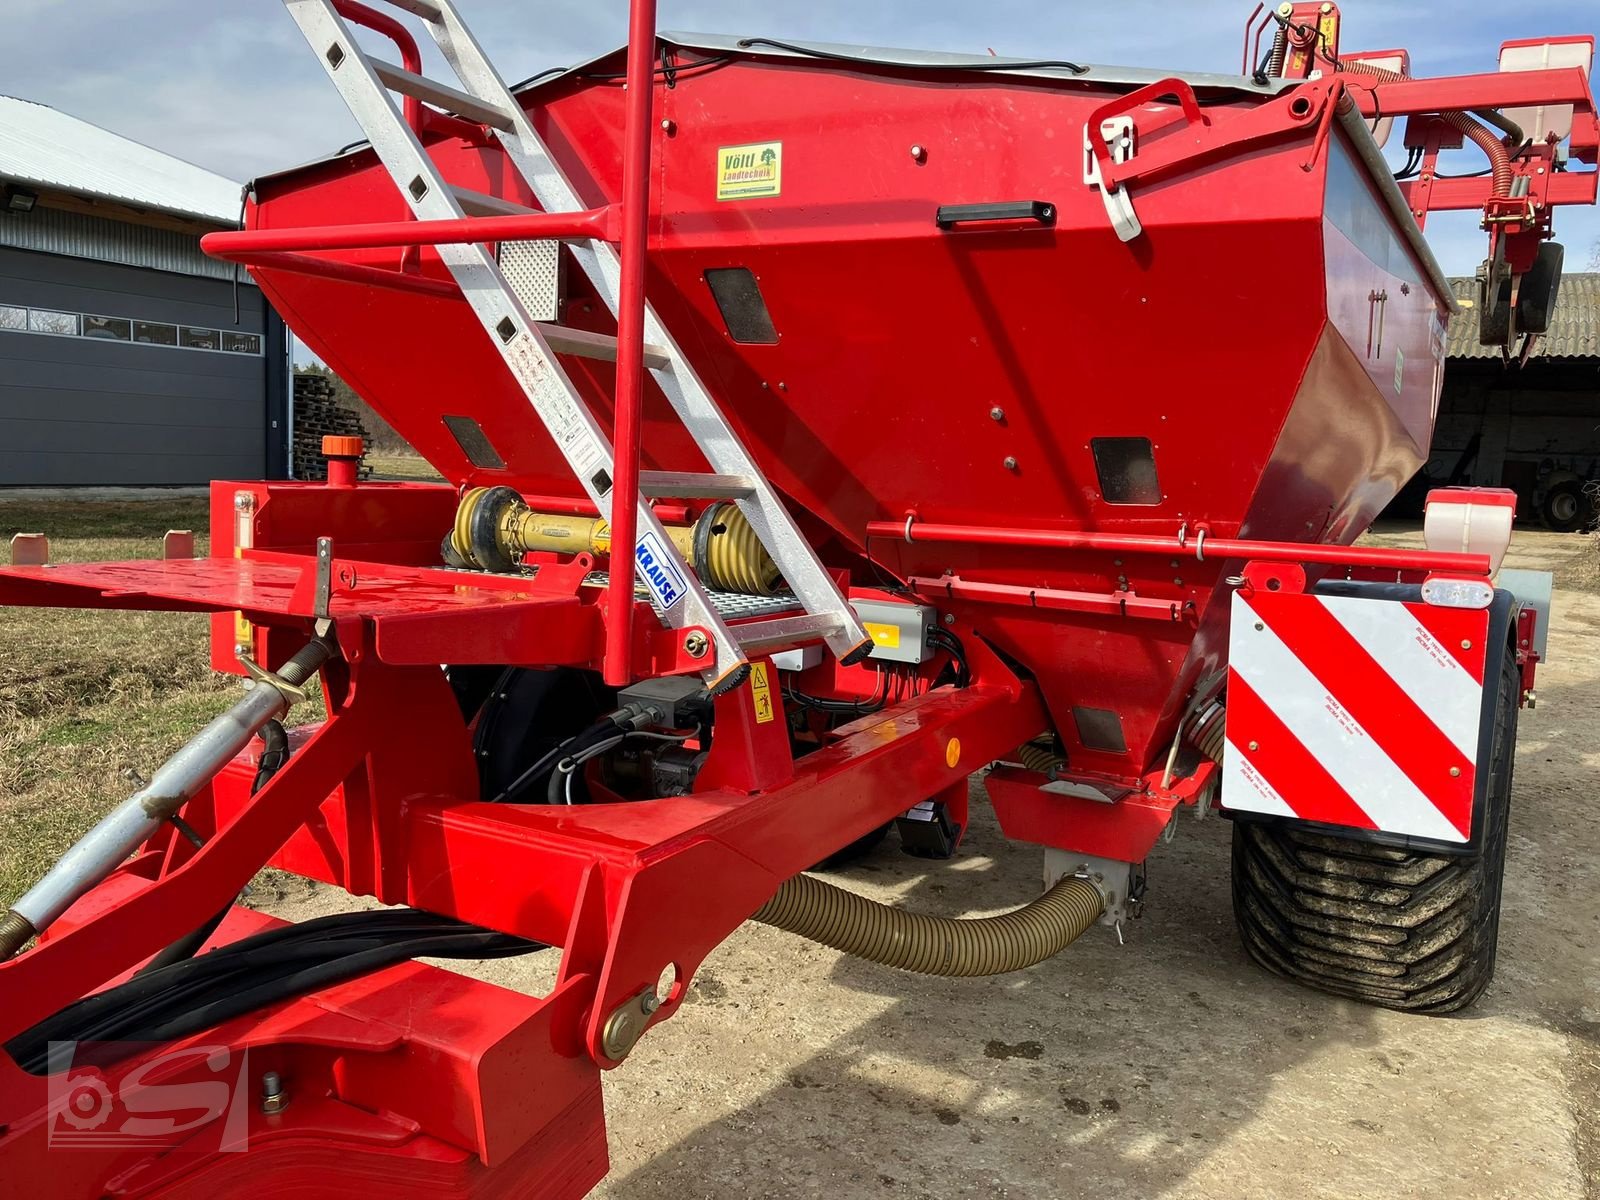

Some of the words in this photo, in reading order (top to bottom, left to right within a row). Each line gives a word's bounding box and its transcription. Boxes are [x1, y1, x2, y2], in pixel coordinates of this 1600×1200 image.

[725, 153, 755, 170] Völtl
[723, 168, 771, 181] Landtechnik
[636, 543, 677, 604] KRAUSE
